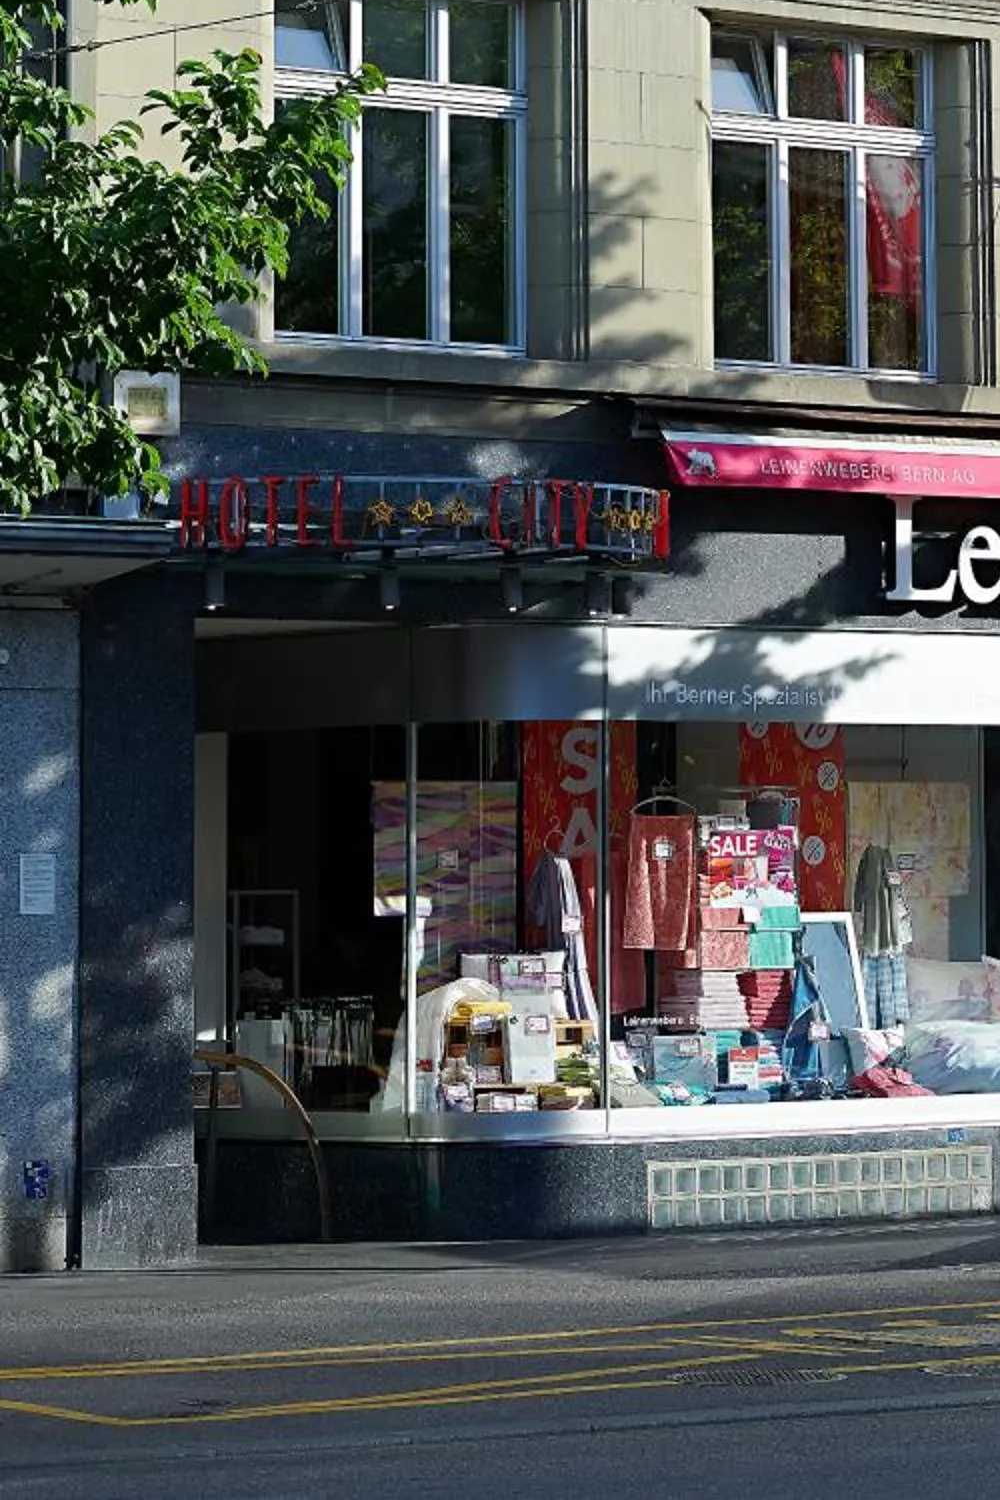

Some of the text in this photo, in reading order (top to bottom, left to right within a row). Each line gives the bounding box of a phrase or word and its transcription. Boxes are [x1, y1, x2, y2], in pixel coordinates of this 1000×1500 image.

[902, 464, 945, 484] BERN
[951, 467, 976, 485] AG
[179, 474, 355, 551] HOTEL
[675, 683, 736, 704] Berner
[710, 834, 758, 857] SALE
